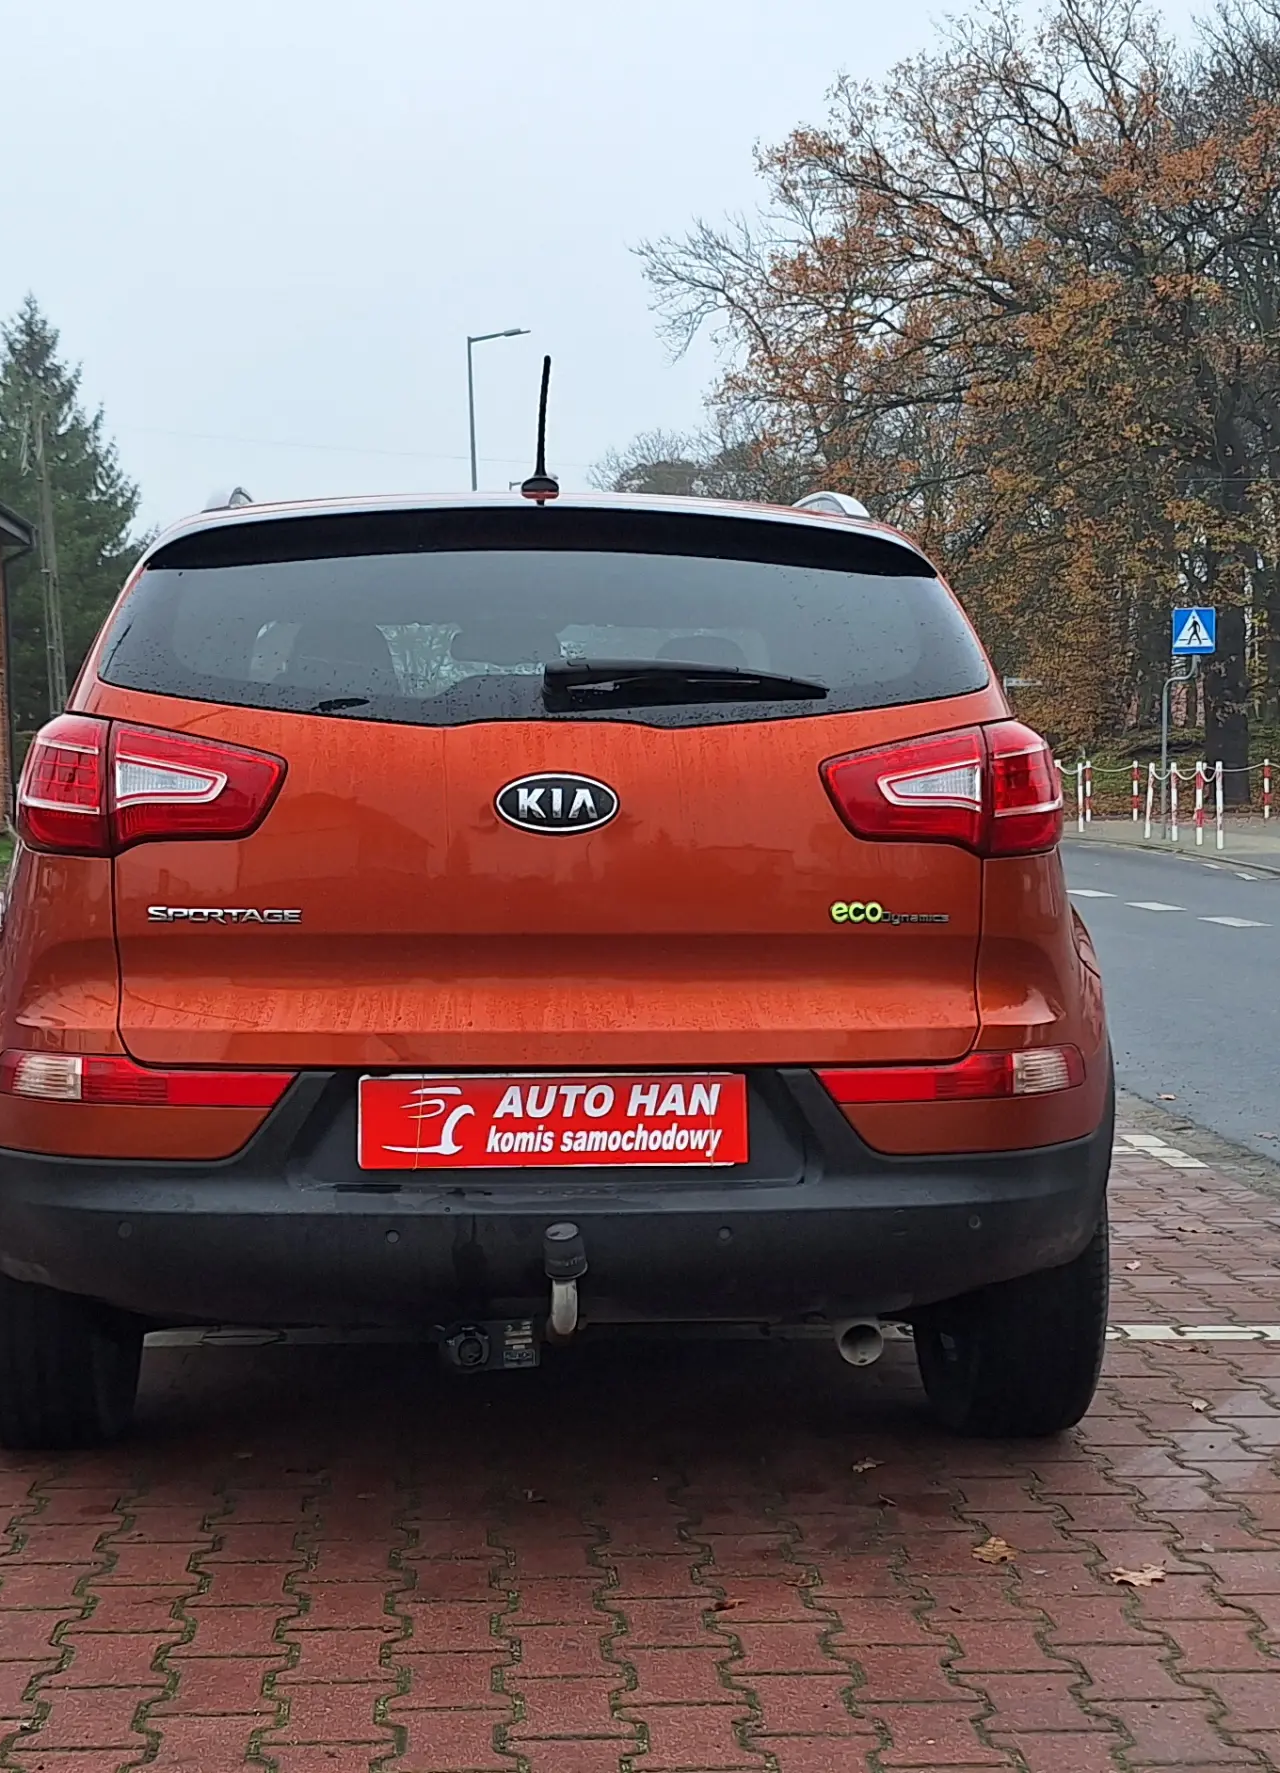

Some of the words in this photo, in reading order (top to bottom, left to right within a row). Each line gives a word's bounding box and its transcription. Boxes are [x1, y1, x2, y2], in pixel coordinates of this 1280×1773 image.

[516, 788, 599, 819] KIA
[147, 905, 303, 925] SPORTAGE
[492, 1084, 613, 1118] AUTO
[626, 1083, 722, 1117] HAN
[485, 1124, 555, 1154] komis
[559, 1122, 723, 1157] samochodowy
